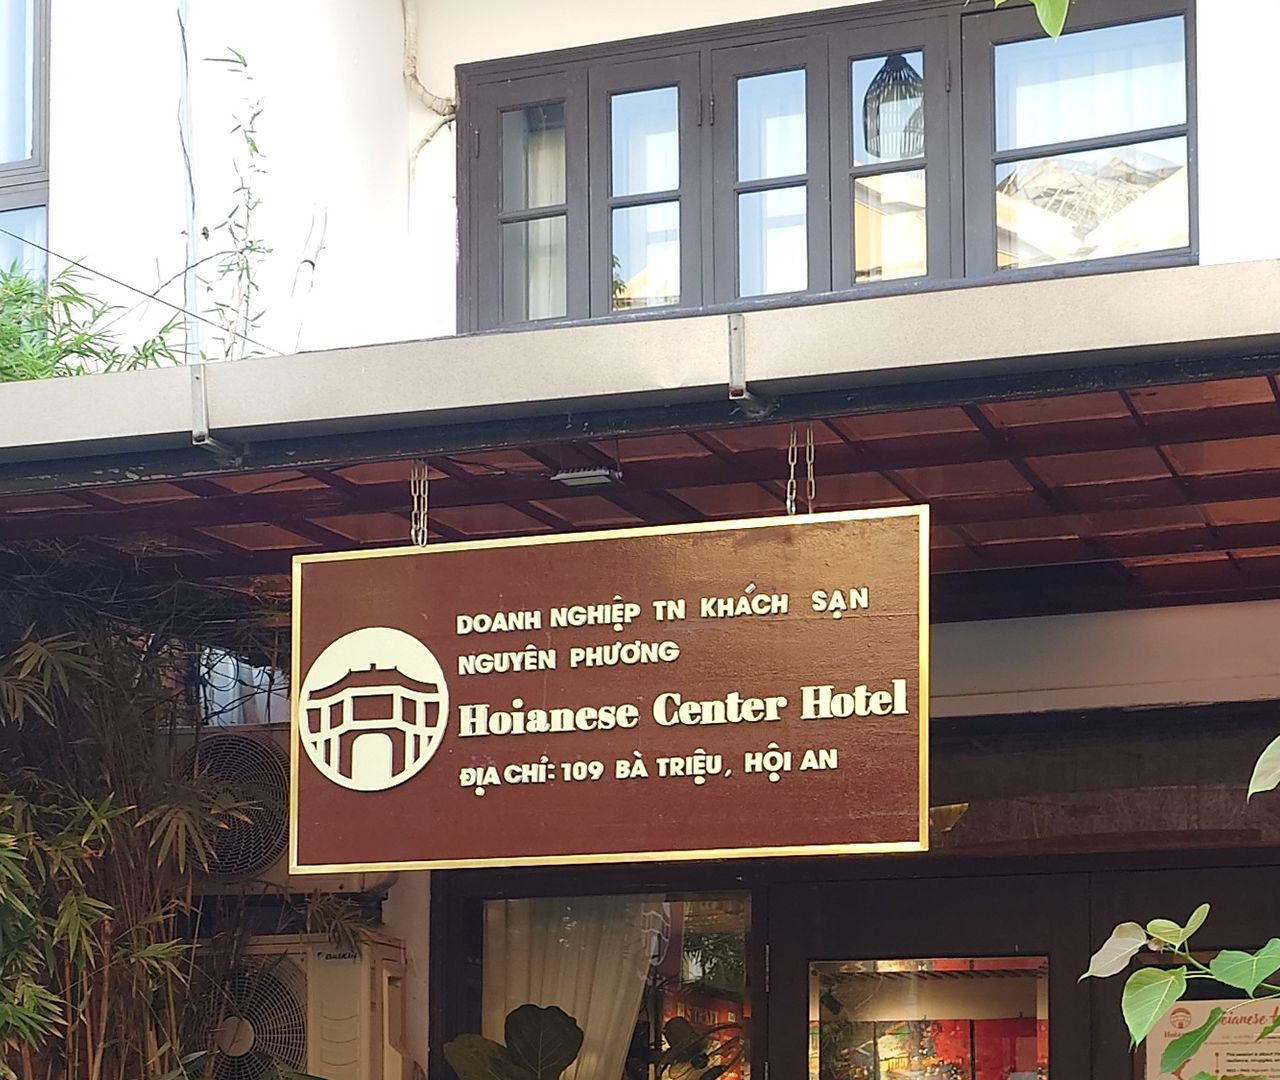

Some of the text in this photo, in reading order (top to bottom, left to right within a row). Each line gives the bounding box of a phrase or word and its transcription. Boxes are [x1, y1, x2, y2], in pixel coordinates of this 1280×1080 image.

[456, 583, 870, 636] DOANH NGHIỆP TN KHÁCH SẠN
[458, 640, 681, 676] NGUYÊN PHƯƠNG
[458, 678, 910, 738] Hoianese Center Hotel
[459, 742, 840, 797] ĐỊA CHỈ: 109 BÀ TRIỆU, HỘI AN
[1219, 1011, 1266, 1026] oianese
